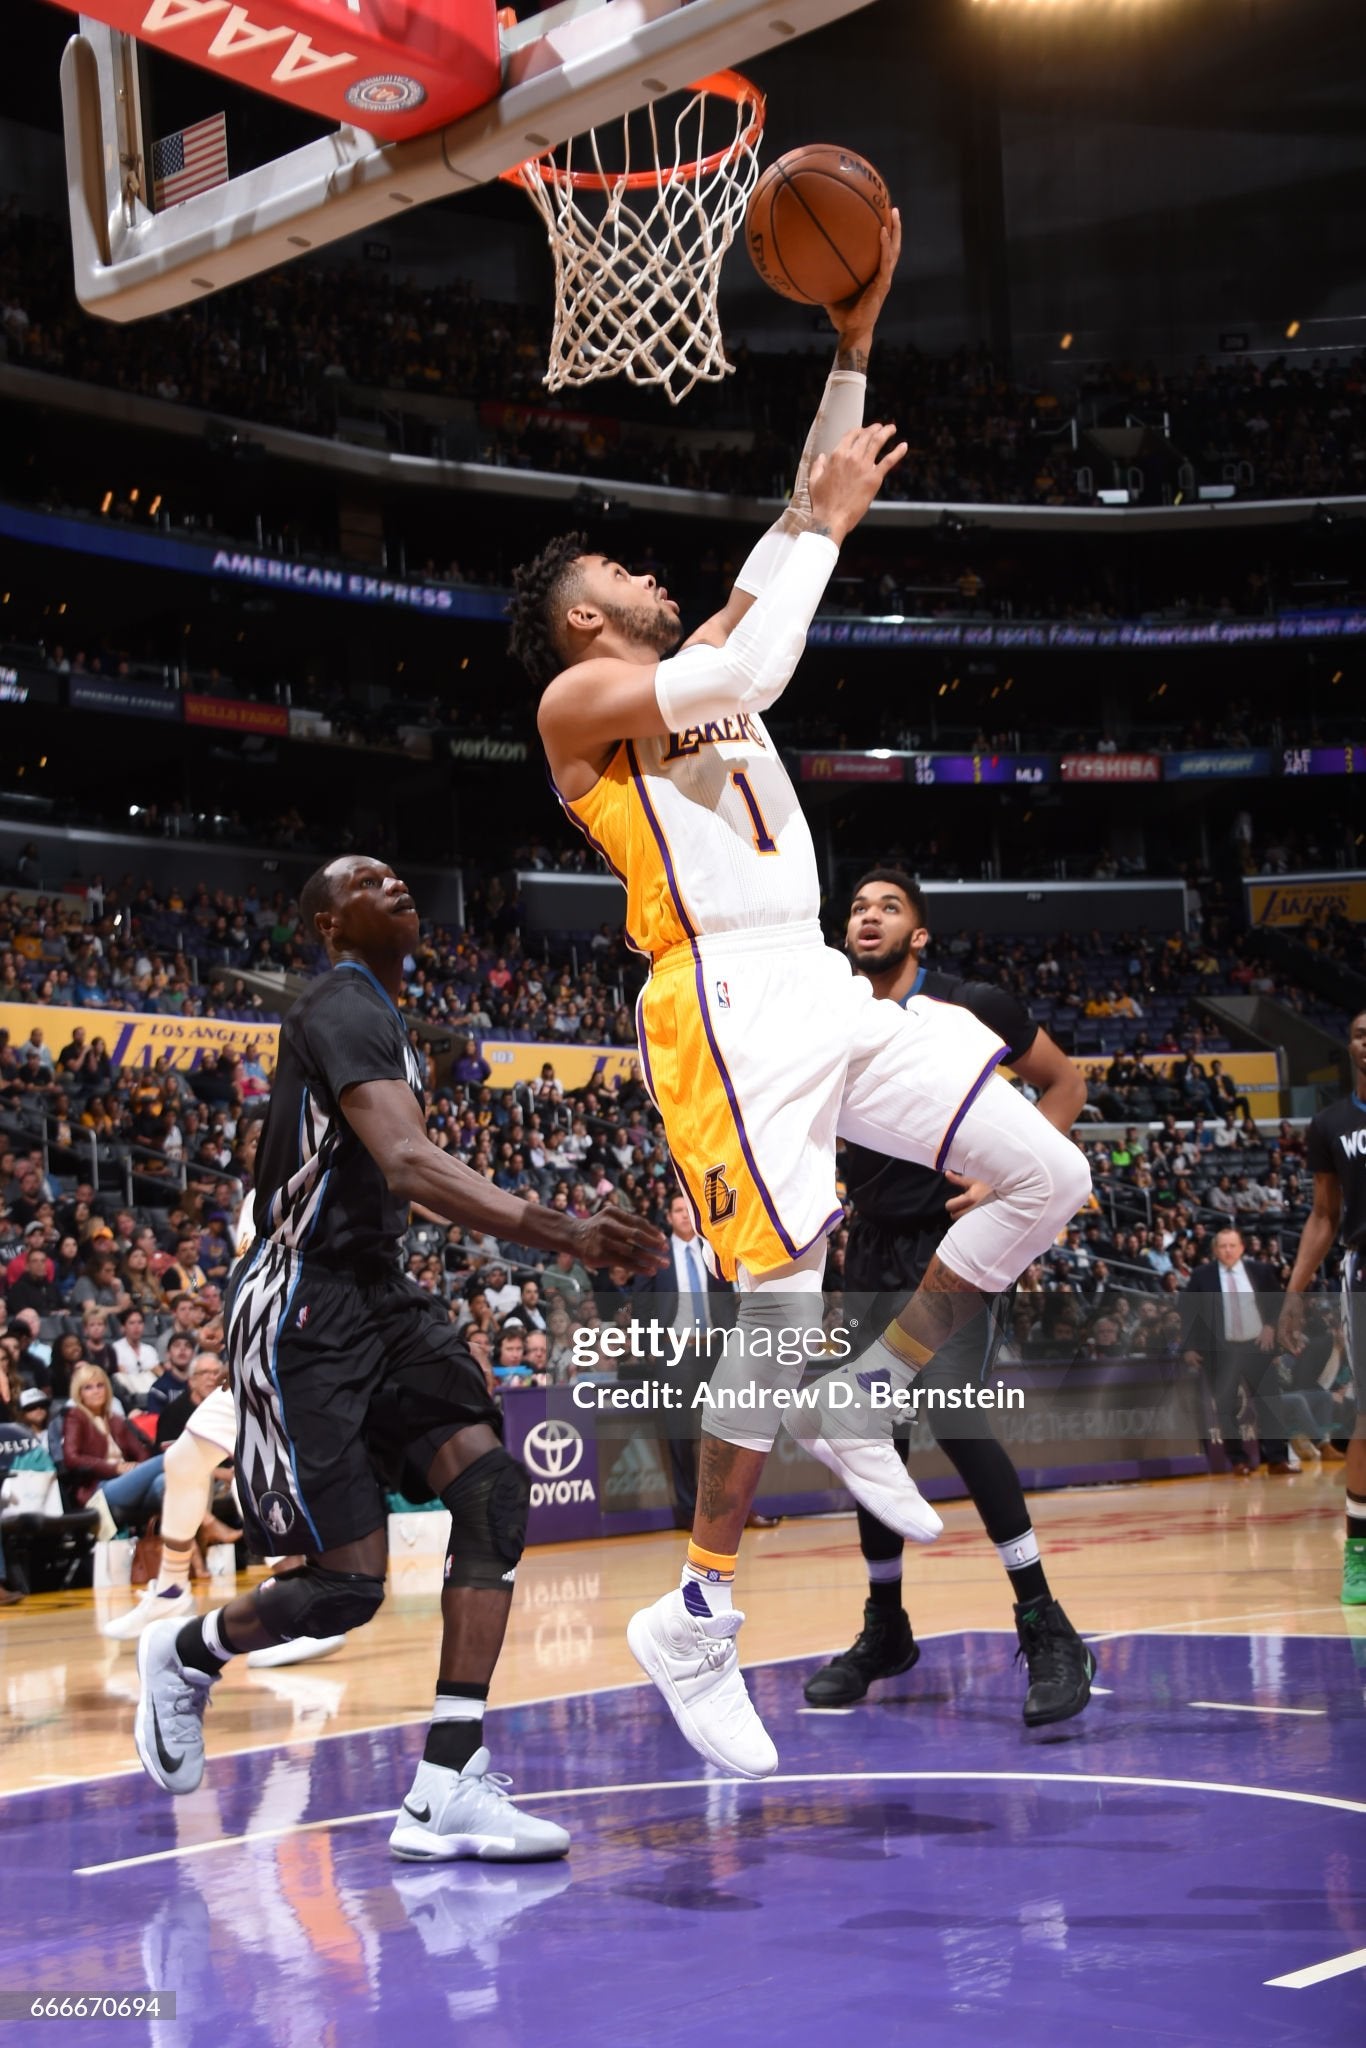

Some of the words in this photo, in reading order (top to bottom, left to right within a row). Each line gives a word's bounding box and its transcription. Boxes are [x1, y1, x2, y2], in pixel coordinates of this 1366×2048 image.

[212, 550, 343, 589] AMERICAN
[349, 574, 453, 609] EXPRESS
[187, 703, 239, 723] WELLS
[240, 708, 288, 728] FARGO
[449, 737, 526, 761] verizon
[1015, 767, 1043, 783] MLB
[1064, 758, 1157, 779] TOSHIBA
[730, 769, 780, 857] 1
[151, 1023, 184, 1038] LOS
[189, 1027, 275, 1045] ANGELES
[529, 1478, 596, 1507] OYOTA
